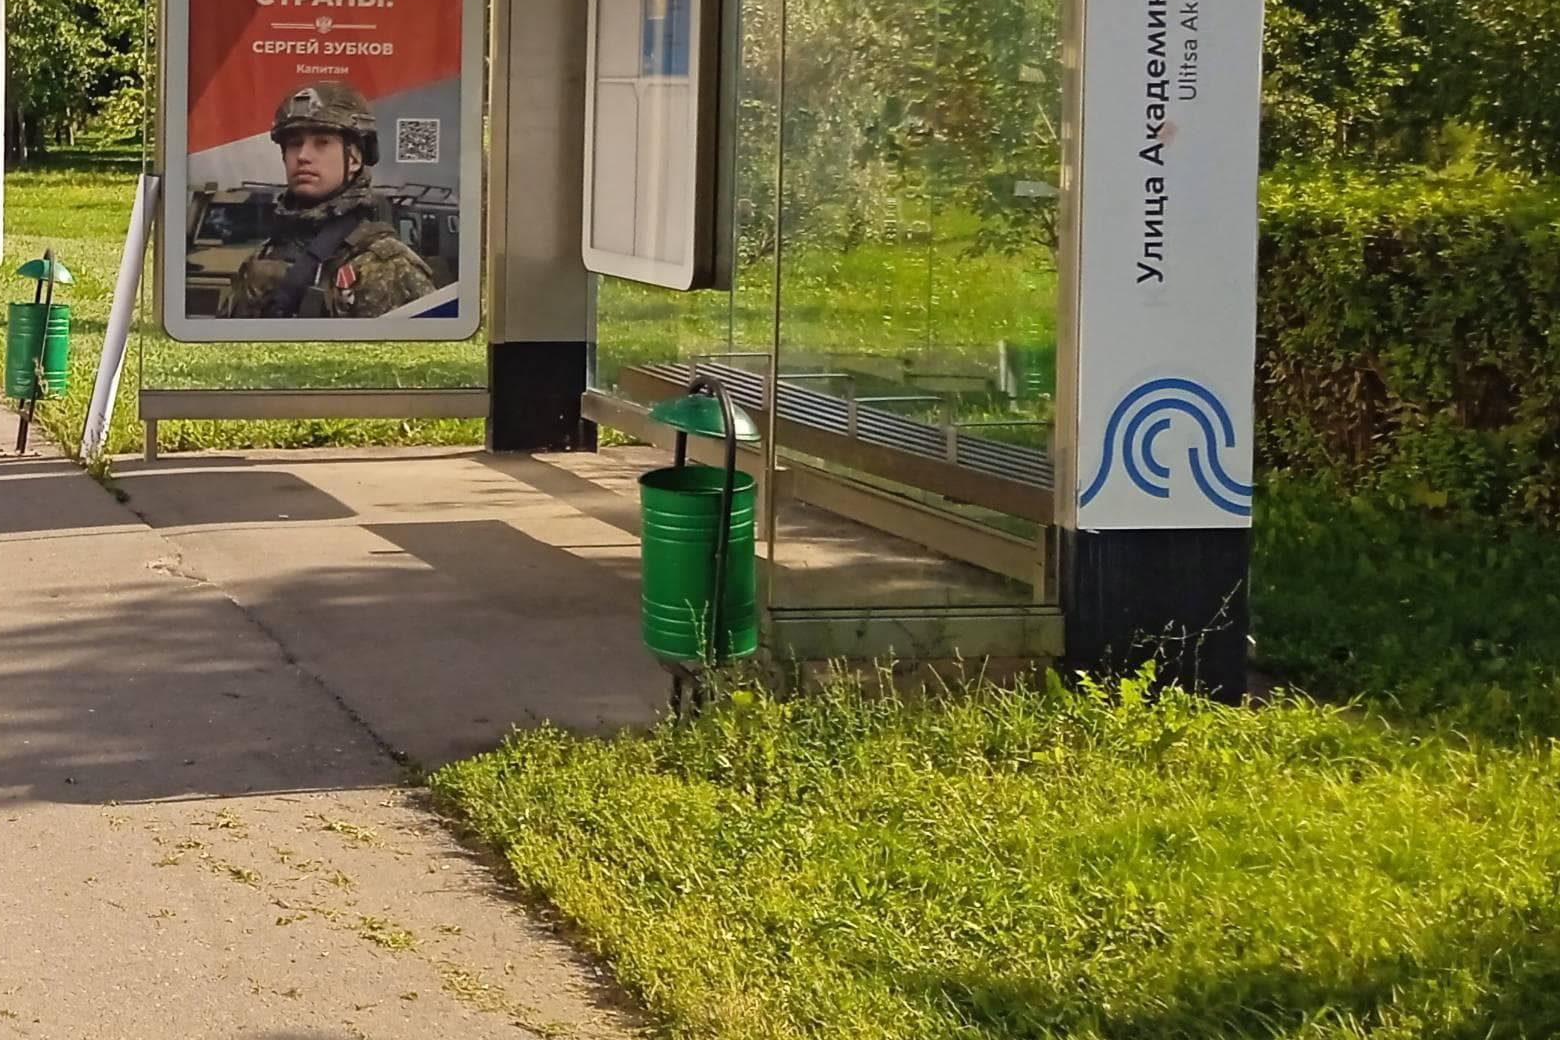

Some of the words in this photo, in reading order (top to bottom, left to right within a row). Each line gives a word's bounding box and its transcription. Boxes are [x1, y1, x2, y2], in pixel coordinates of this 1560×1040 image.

[252, 38, 319, 55] СЕРГЕЙ
[323, 42, 394, 56] ЗУБКОВ
[296, 64, 349, 75] Капитан
[1178, 39, 1198, 101] Ulitsa
[1137, 176, 1169, 283] Улица
